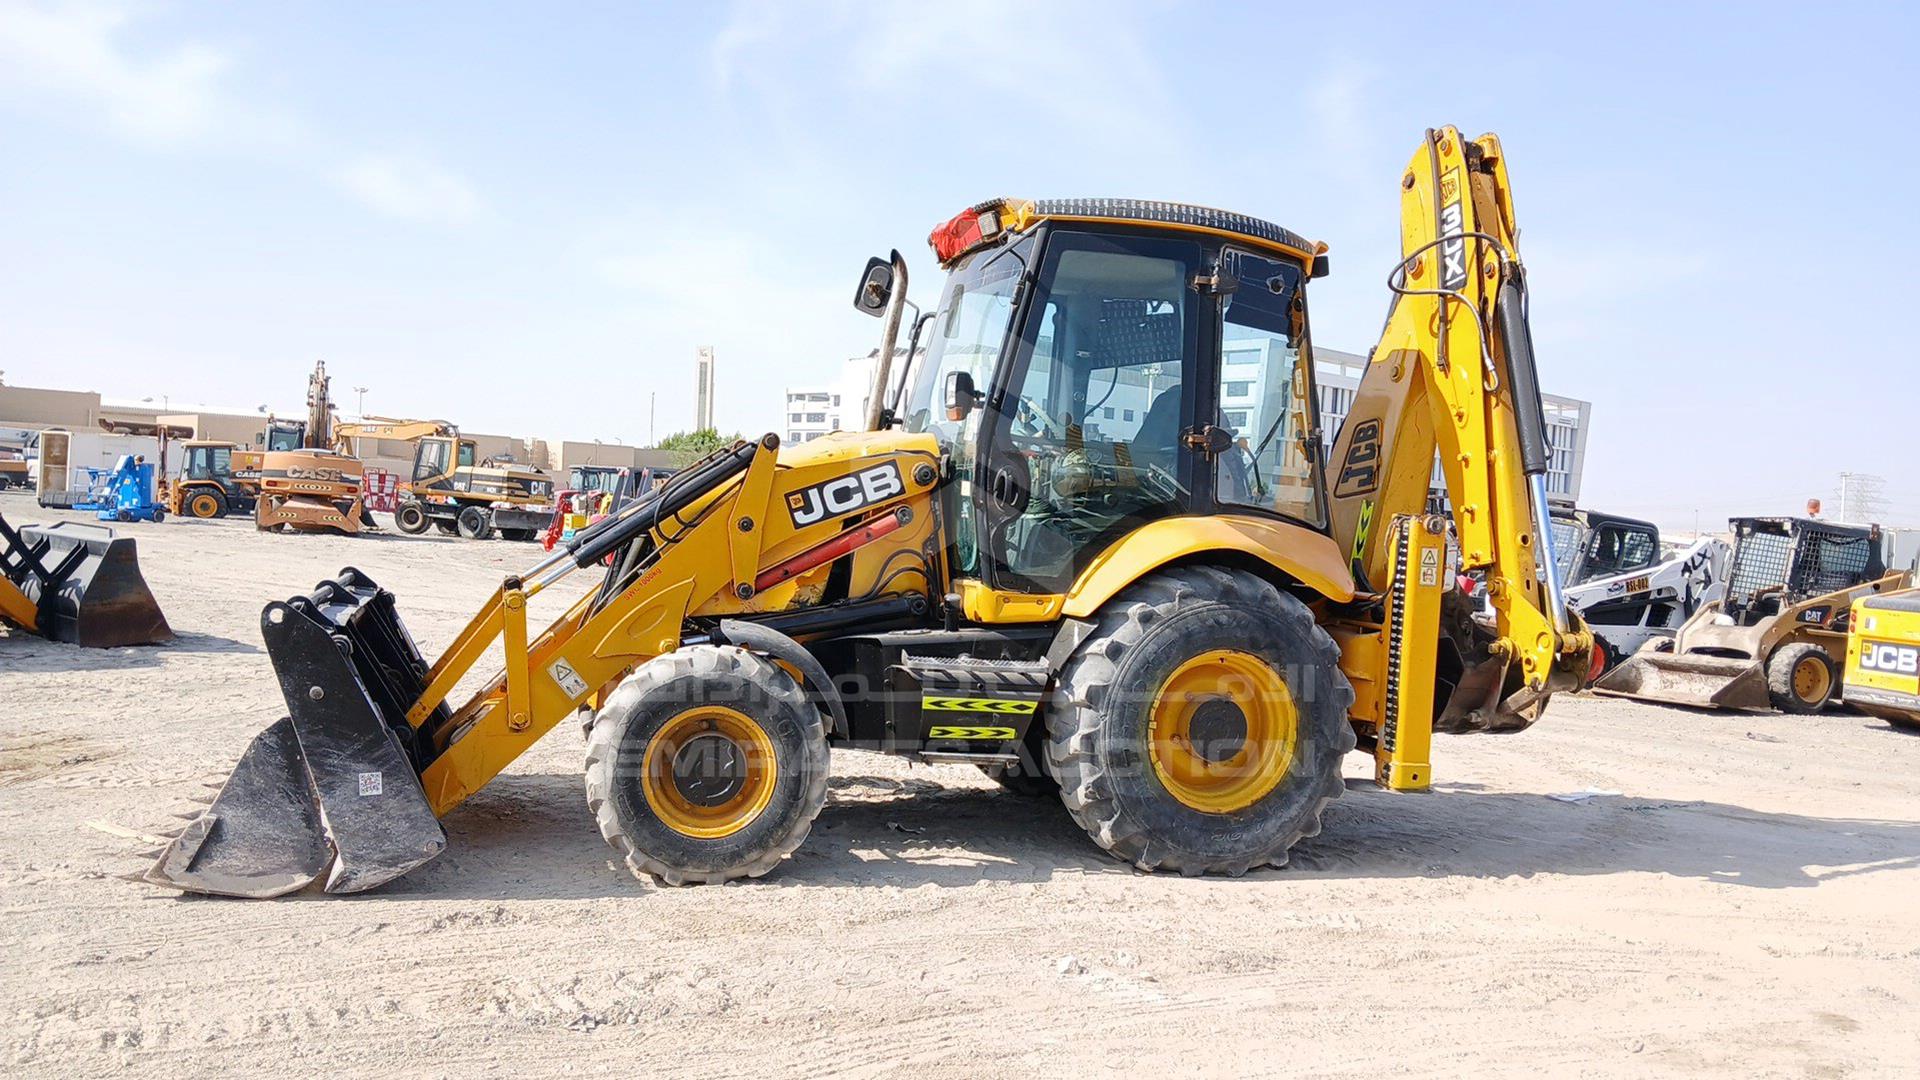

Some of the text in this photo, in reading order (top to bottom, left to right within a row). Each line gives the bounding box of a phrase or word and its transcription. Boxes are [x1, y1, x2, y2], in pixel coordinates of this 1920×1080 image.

[1441, 203, 1465, 281] 3CX
[1340, 424, 1378, 488] JCB
[286, 465, 343, 480] CASE
[530, 481, 546, 495] CAT
[793, 464, 902, 525] JCB
[1805, 610, 1822, 623] CAT
[1861, 644, 1917, 673] JCB
